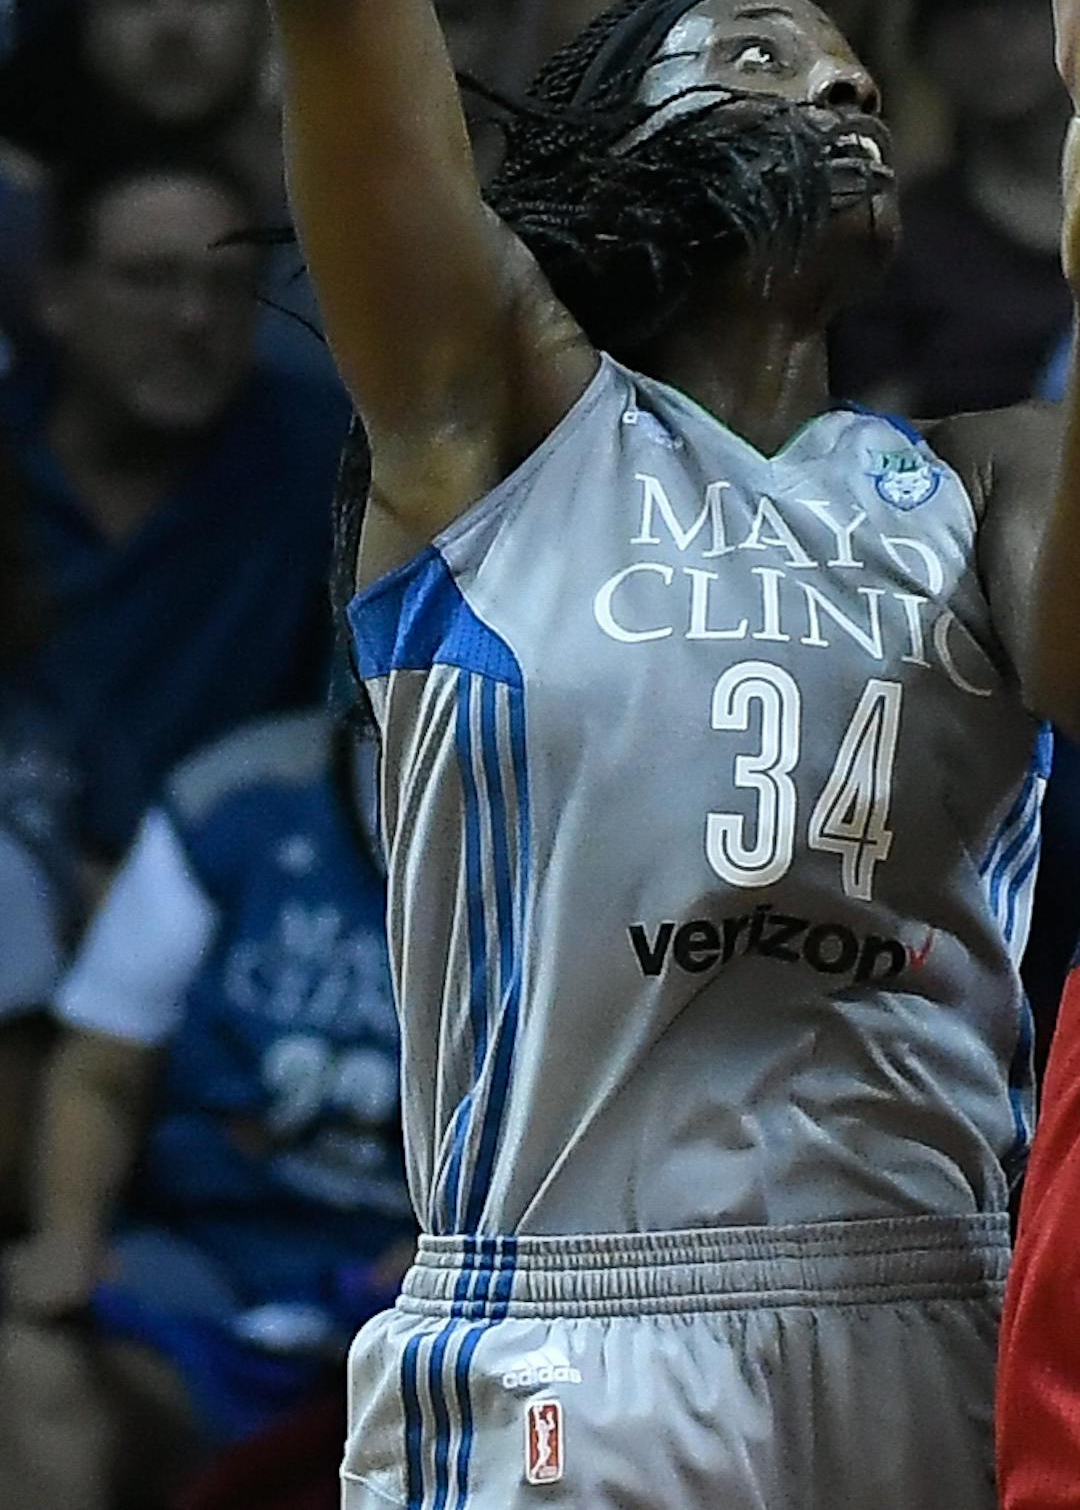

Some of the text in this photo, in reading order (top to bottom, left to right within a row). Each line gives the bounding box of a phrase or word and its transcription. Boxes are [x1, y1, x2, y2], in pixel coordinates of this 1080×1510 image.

[593, 562, 993, 697] CLINIC
[705, 659, 902, 902] 34
[627, 903, 907, 982] verizon
[502, 1365, 583, 1389] adidas
